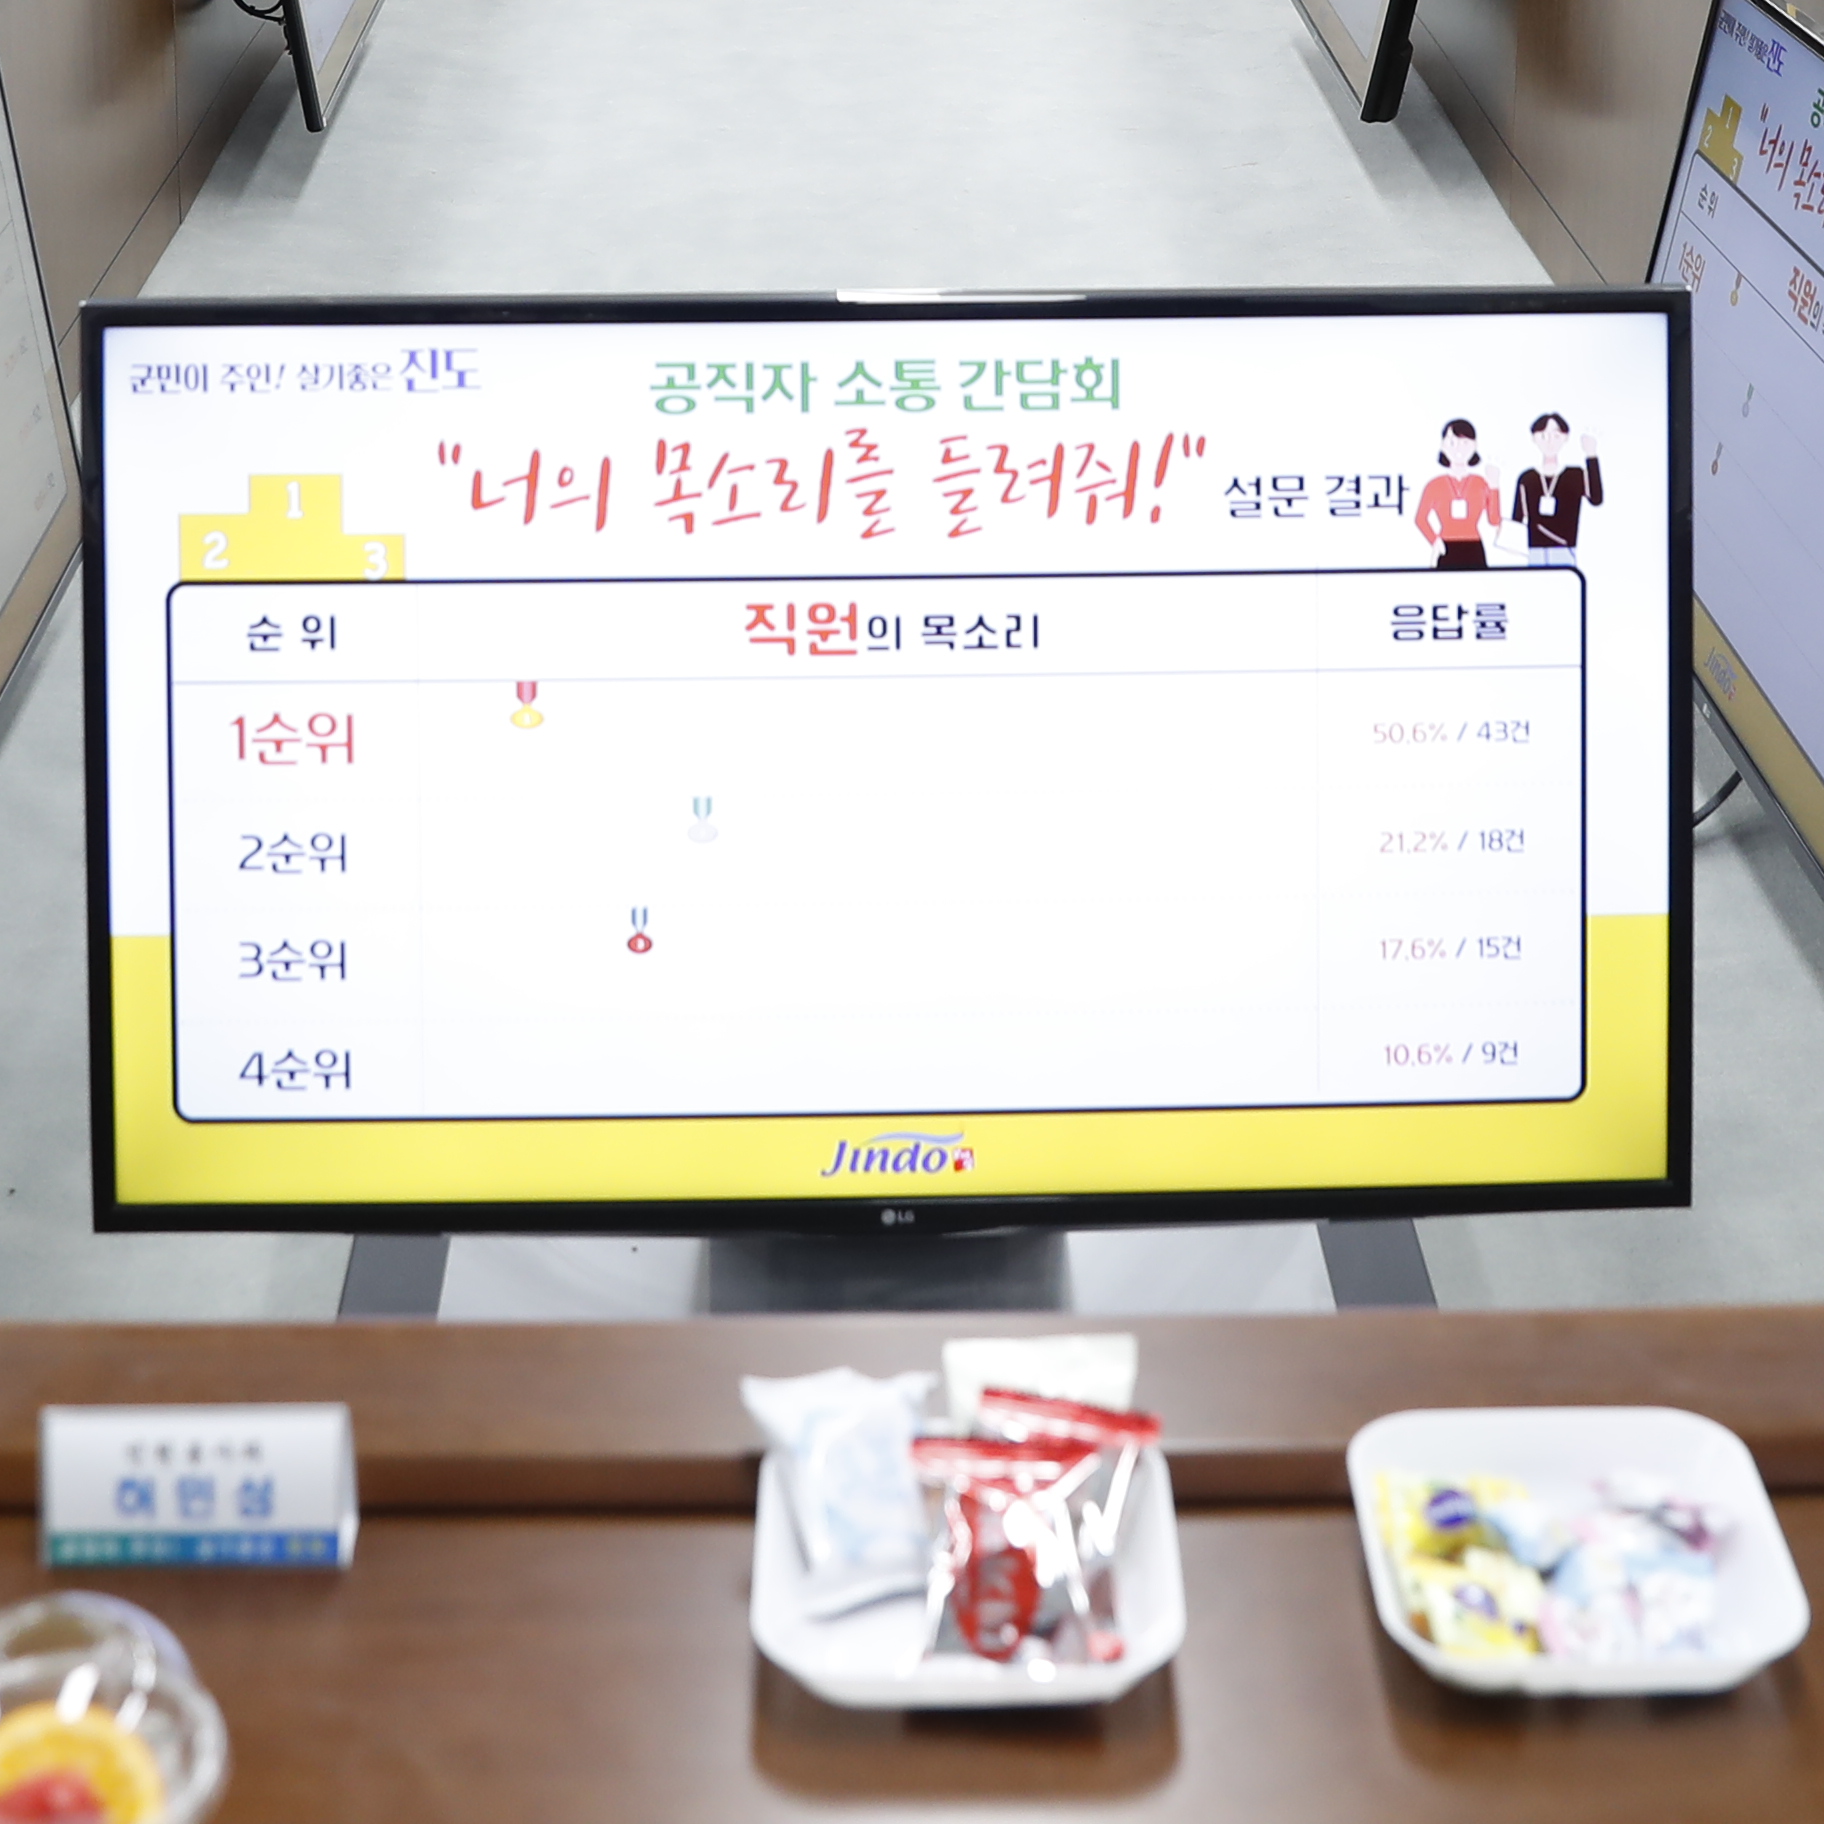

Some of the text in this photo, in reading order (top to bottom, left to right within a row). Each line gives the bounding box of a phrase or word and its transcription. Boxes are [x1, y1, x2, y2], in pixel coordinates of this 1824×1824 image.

[1788, 266, 1824, 332] 직원의
[129, 347, 481, 395] 군민이 주인! 살기좋은 진도
[650, 355, 1121, 415] 공직자 소통 간담회
[284, 480, 304, 520] 1
[438, 427, 1206, 540] "너의 목소리를 들려줘!"
[1223, 473, 1410, 519] 설문 결과
[202, 531, 230, 570] 2
[363, 541, 389, 580] 3
[744, 602, 1040, 656] 직원의 목소리
[1390, 601, 1510, 642] 응답률
[229, 711, 354, 765] 1순위
[1373, 721, 1448, 745] 50.6%
[1476, 719, 1531, 744] 43건
[237, 831, 347, 874] 2순위
[1379, 830, 1449, 854] 21.2%
[1478, 827, 1525, 854] 18건
[238, 938, 347, 982] 3순위
[1379, 937, 1447, 961] 17.6%
[1477, 935, 1522, 960] 15건
[238, 1048, 353, 1092] 4순위
[1384, 1042, 1454, 1067] 10.6%
[1481, 1040, 1519, 1066] 9건
[821, 1139, 948, 1177] Jindo
